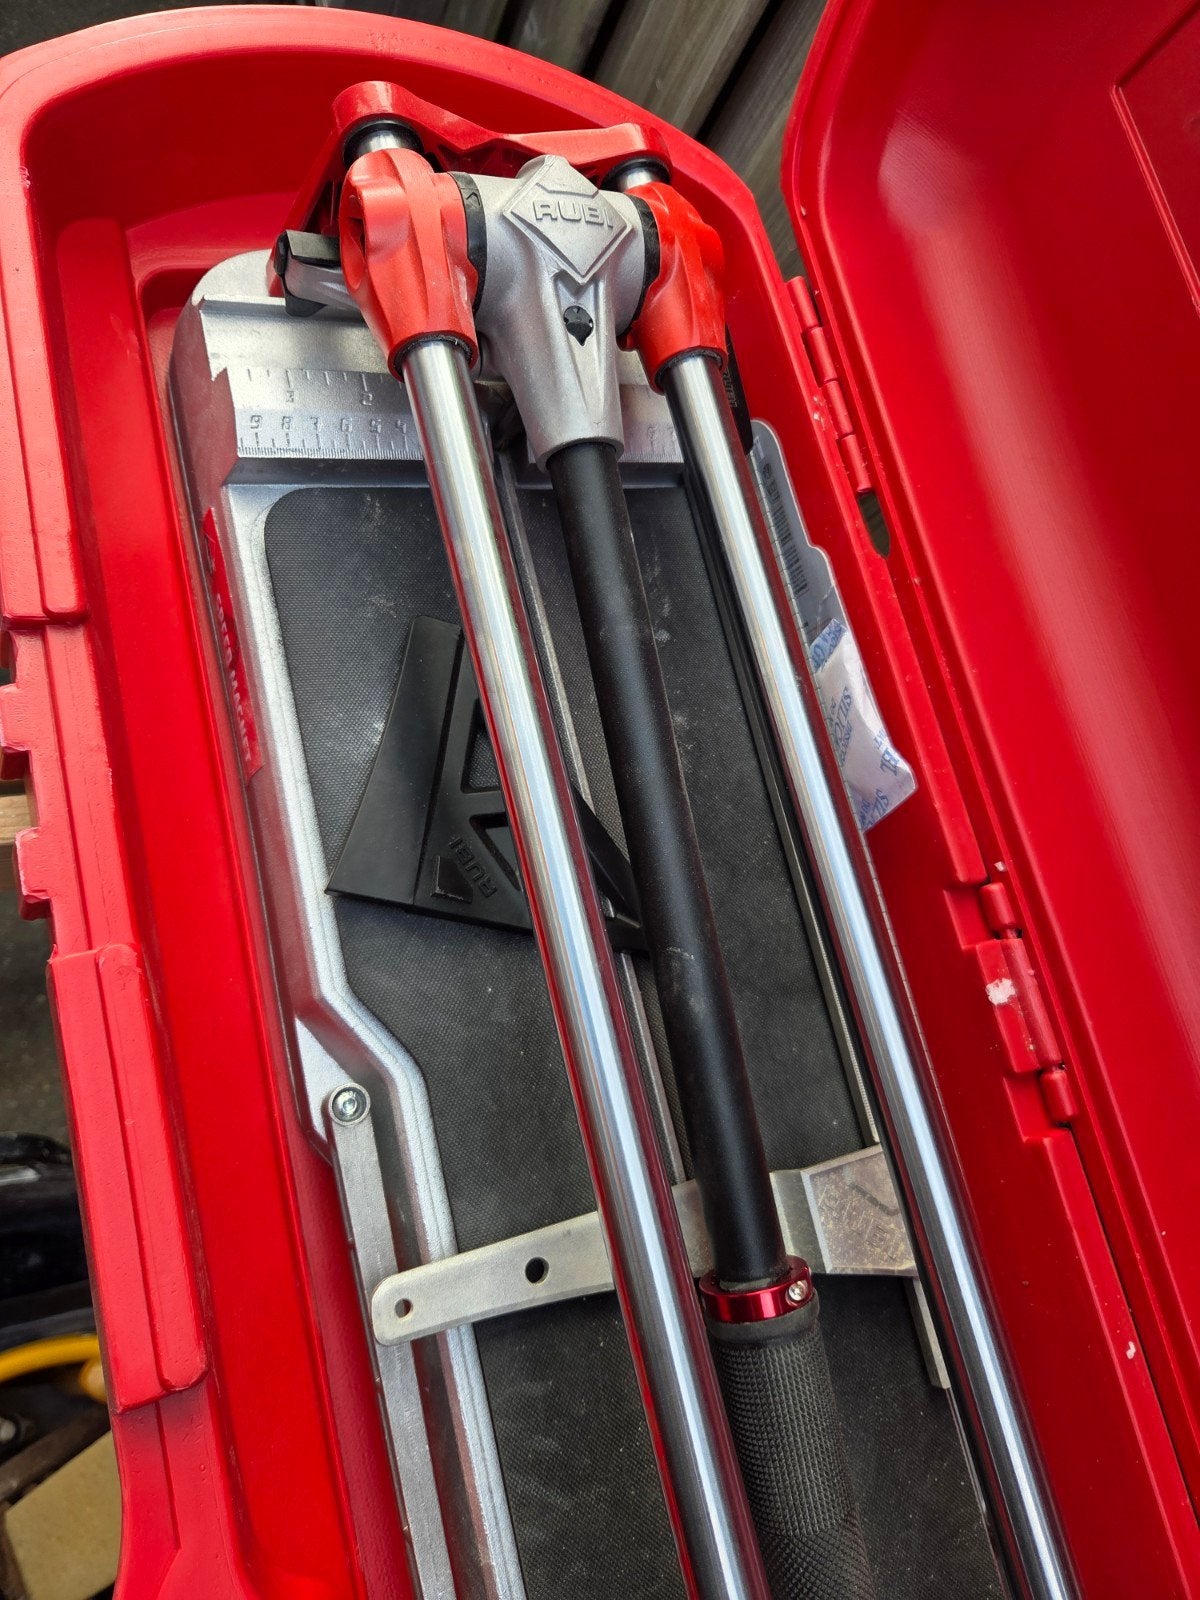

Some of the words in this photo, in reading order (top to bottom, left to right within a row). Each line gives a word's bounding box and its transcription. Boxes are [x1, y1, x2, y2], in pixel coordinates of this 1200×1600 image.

[533, 201, 613, 228] RUBI
[362, 392, 373, 406] 2
[250, 415, 262, 430] 9
[282, 415, 292, 430] 8
[340, 417, 352, 433] 6
[370, 418, 382, 433] 5
[448, 837, 498, 898] RUBI
